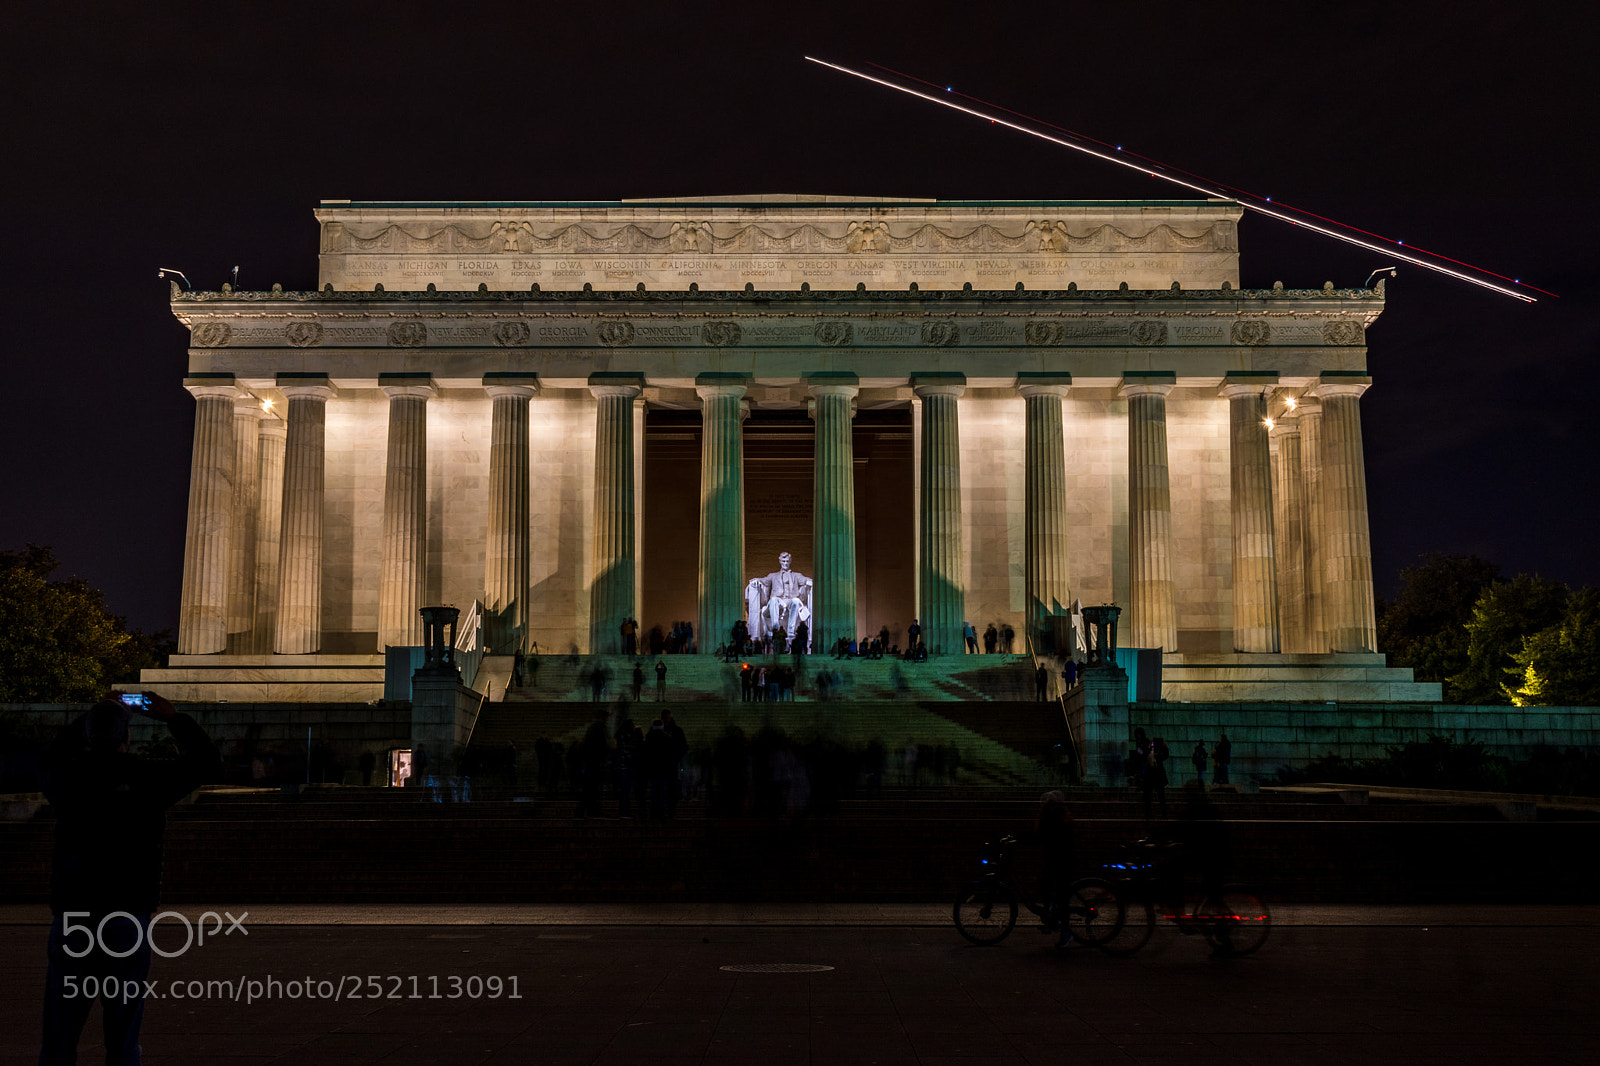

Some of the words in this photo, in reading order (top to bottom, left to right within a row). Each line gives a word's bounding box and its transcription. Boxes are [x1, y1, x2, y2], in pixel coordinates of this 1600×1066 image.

[398, 261, 448, 270] MICHIGAN
[458, 261, 499, 270] FLORIDA
[511, 261, 543, 270] TEXAS
[555, 261, 583, 270] IOWA
[594, 261, 651, 270] WISCONSIN
[661, 261, 717, 270] CALIFORNIA
[729, 261, 787, 270] MINNESOTA
[797, 261, 838, 270] OREGON
[847, 261, 884, 269] KANSAS
[893, 261, 918, 269] WEST
[920, 261, 965, 269] VIRGINIA
[976, 261, 1012, 269] NEVADA
[1021, 261, 1070, 269] NEBRASKA
[232, 327, 287, 337] DELAWARE
[325, 327, 389, 337] PENNSYLVANIA
[429, 327, 453, 337] NEW
[454, 327, 490, 337] JERSEY
[539, 327, 588, 337] GEORGIA
[636, 325, 701, 336] CONNECTICUT
[857, 326, 917, 336] MARYLAND
[1174, 326, 1224, 336] VIRGINIA
[1270, 326, 1294, 336] NEW
[1295, 326, 1324, 336] YORK
